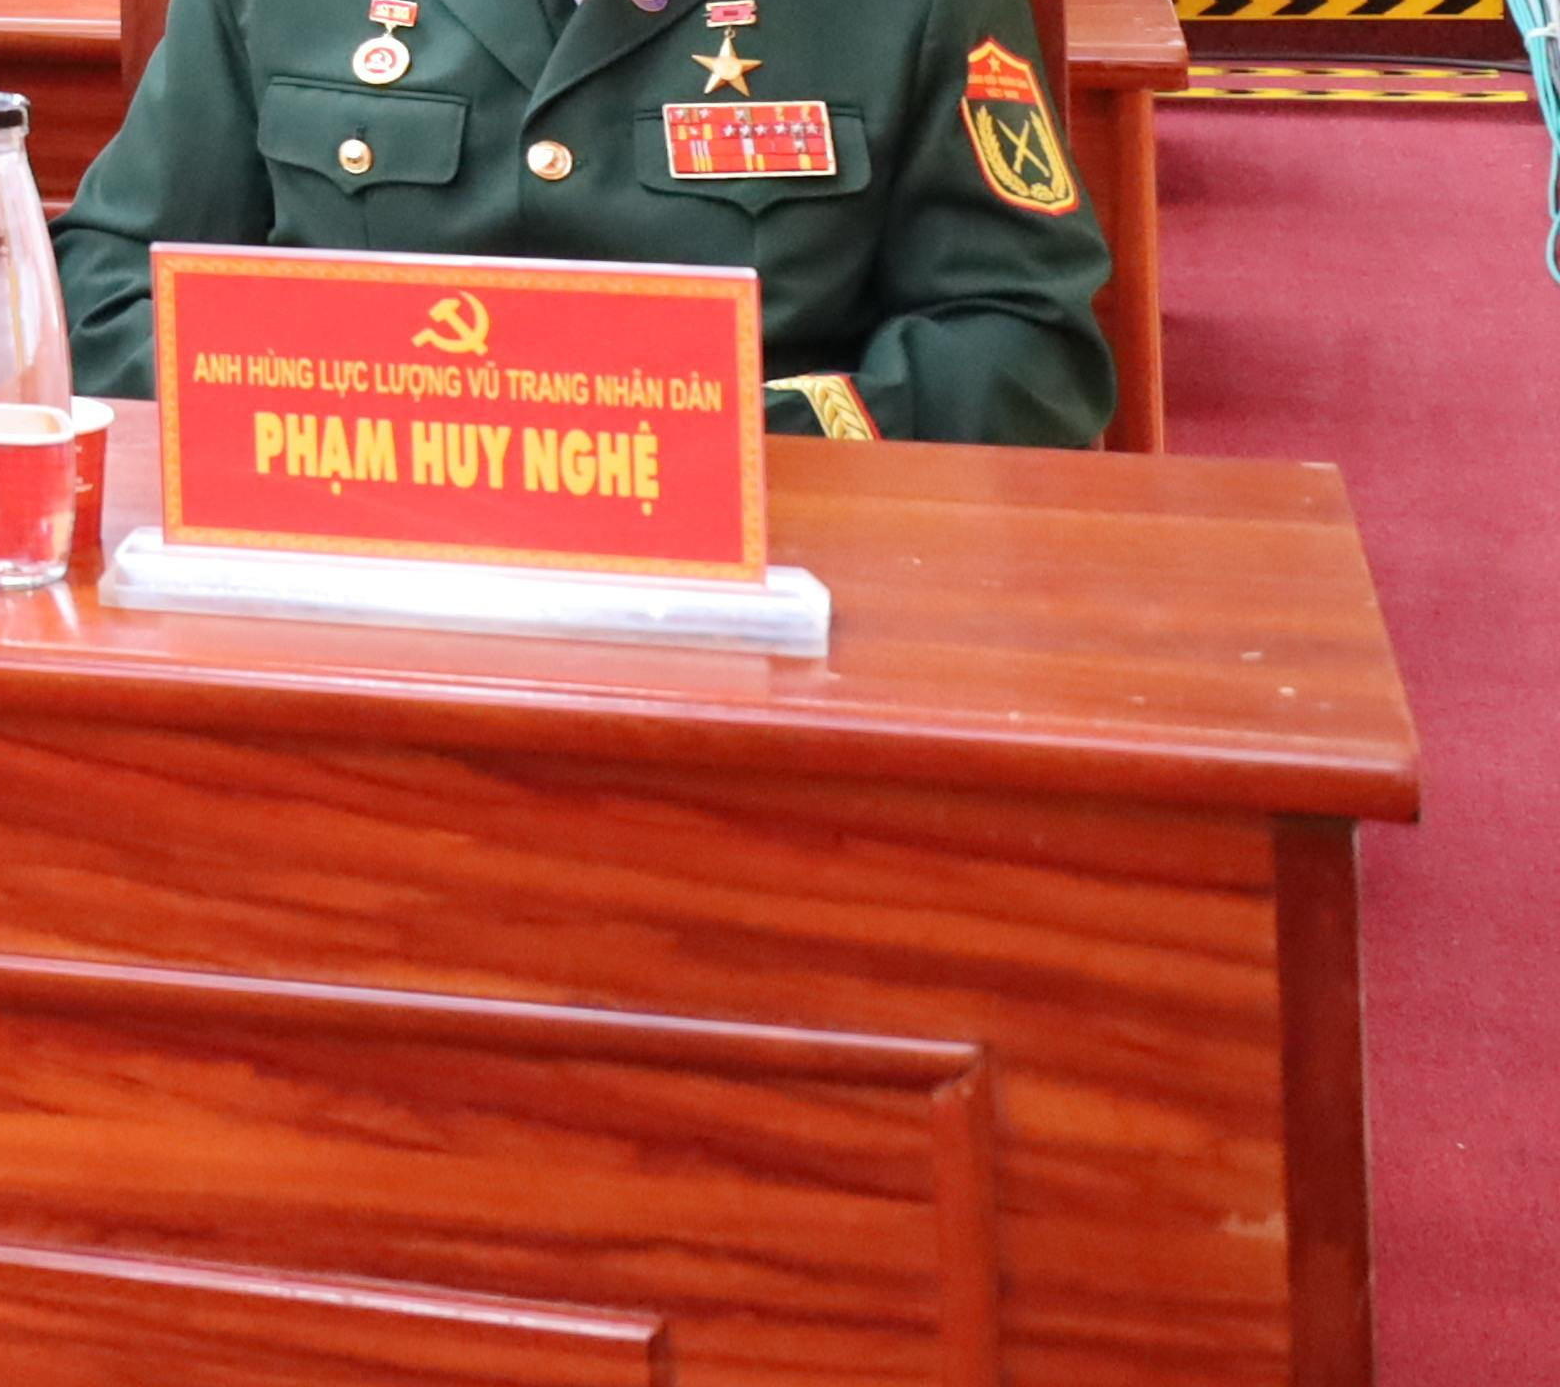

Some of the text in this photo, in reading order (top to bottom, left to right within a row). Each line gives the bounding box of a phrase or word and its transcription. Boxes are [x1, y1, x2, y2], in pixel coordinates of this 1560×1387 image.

[194, 348, 721, 411] ANH HÙNG LỰC LƯỢNG VŨ TRANG NHÂN DÂN
[255, 412, 658, 515] PHẠM HUY NGHỆ
